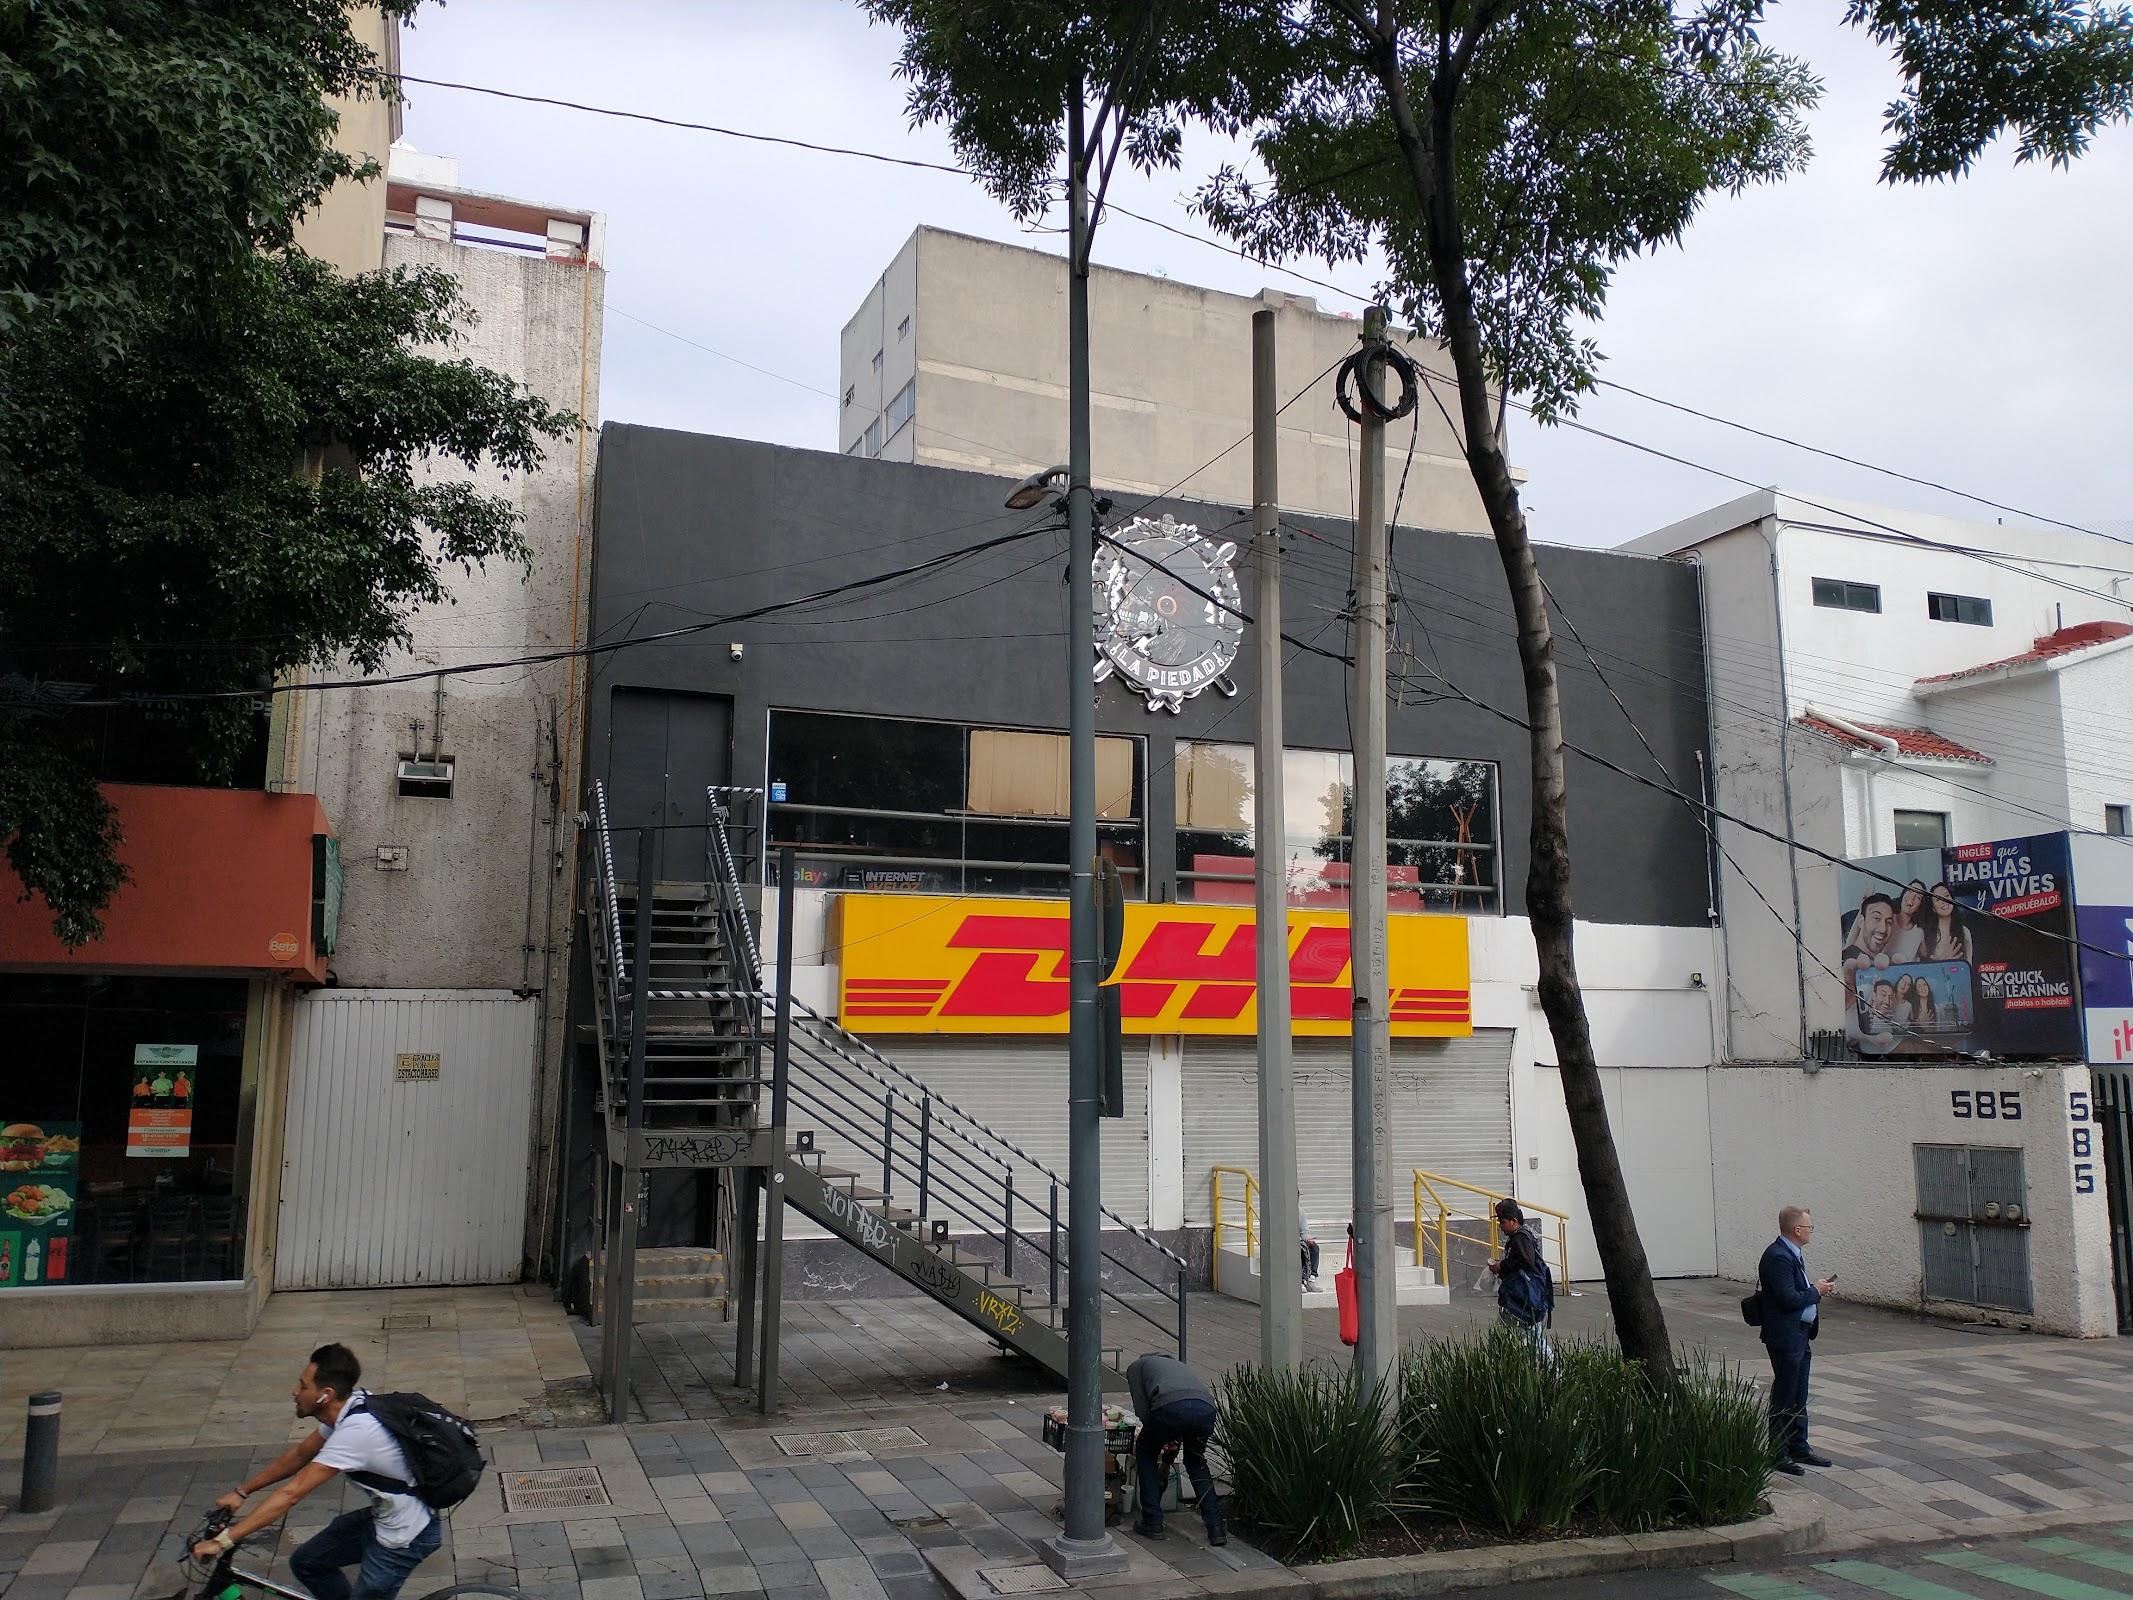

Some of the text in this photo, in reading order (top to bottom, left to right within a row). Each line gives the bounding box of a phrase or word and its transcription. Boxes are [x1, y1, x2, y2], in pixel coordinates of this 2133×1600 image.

[1146, 658, 1216, 687] PIEDAD
[1958, 845, 2020, 864] INGLÉS que
[865, 871, 926, 882] INTERNET
[1948, 856, 2032, 883] HABLAS
[1977, 873, 2056, 911] y VIVES
[271, 940, 297, 952] Beta
[937, 914, 1396, 1020] DHL
[2004, 970, 2045, 985] QUICK
[2006, 982, 2069, 998] LEARNING
[412, 1054, 440, 1062] GRACIAS
[412, 1061, 427, 1069] POR
[397, 1068, 440, 1079] ESTACIONARSE
[1951, 1090, 2022, 1121] 585
[2069, 1091, 2095, 1194] 585
